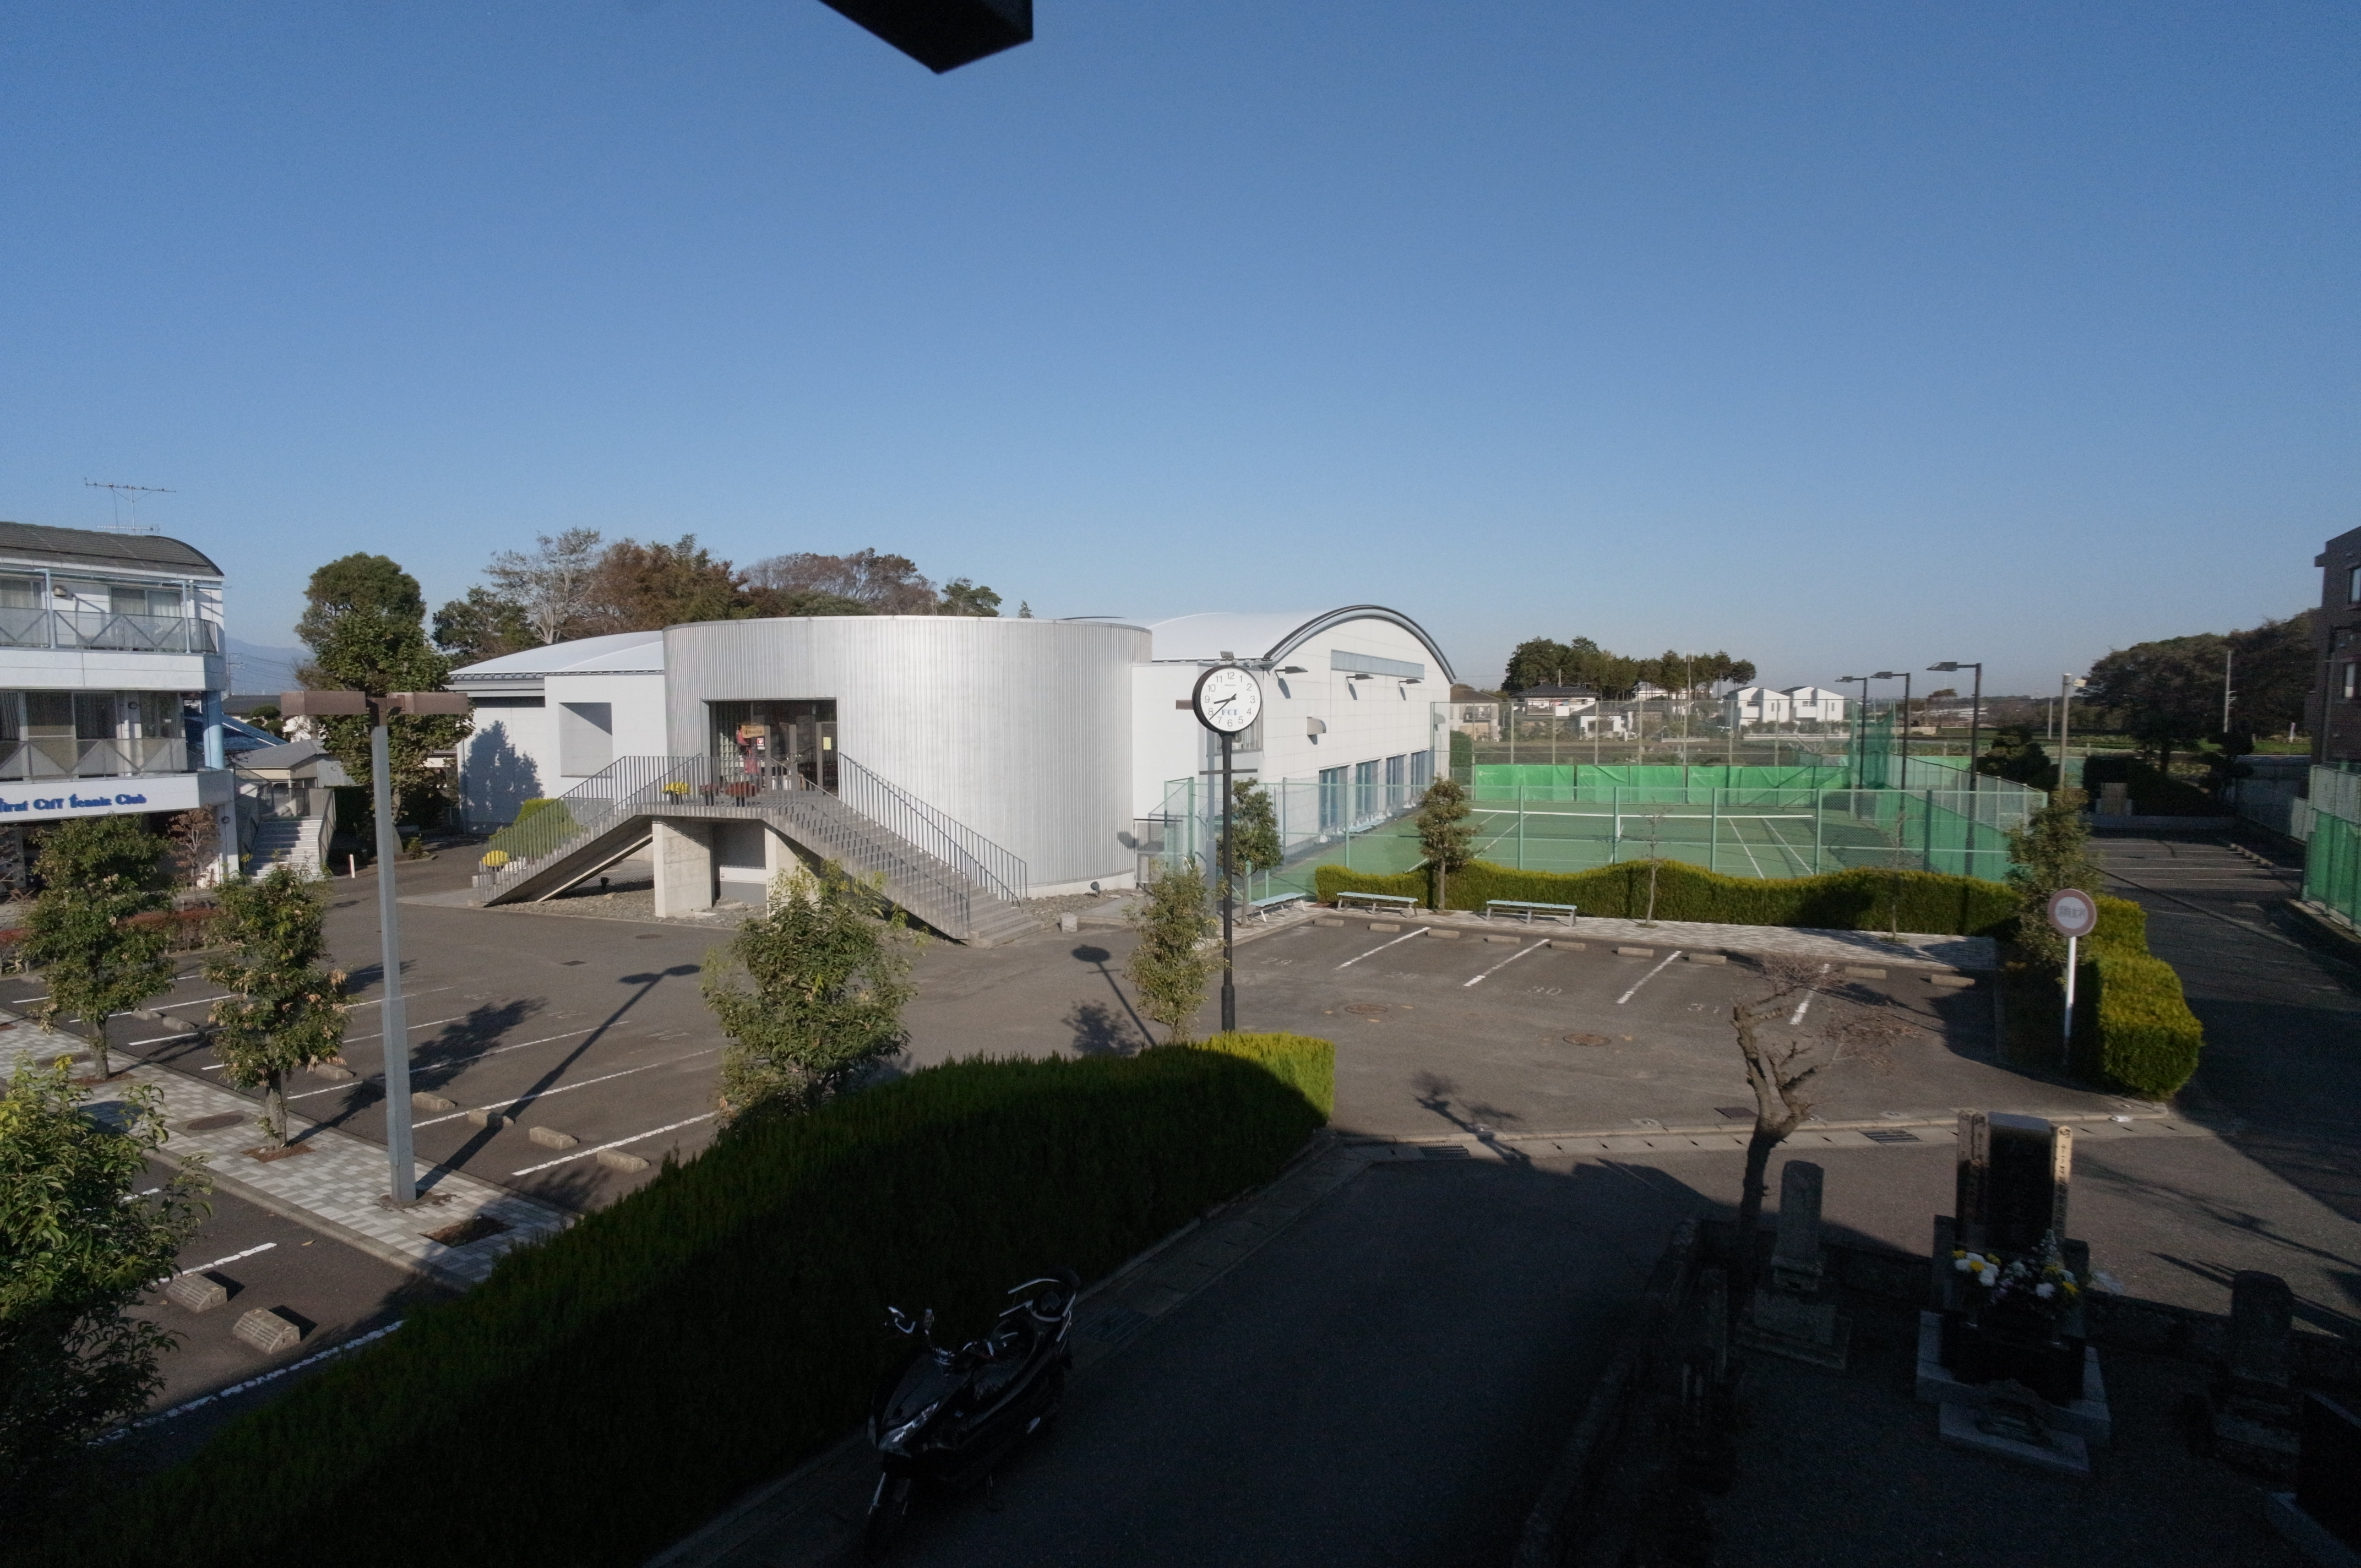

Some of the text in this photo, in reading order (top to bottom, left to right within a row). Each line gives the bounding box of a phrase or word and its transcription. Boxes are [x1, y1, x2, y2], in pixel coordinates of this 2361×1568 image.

[1208, 707, 1214, 716] 8
[1527, 986, 1563, 995] 30
[1687, 1003, 1720, 1014] 31
